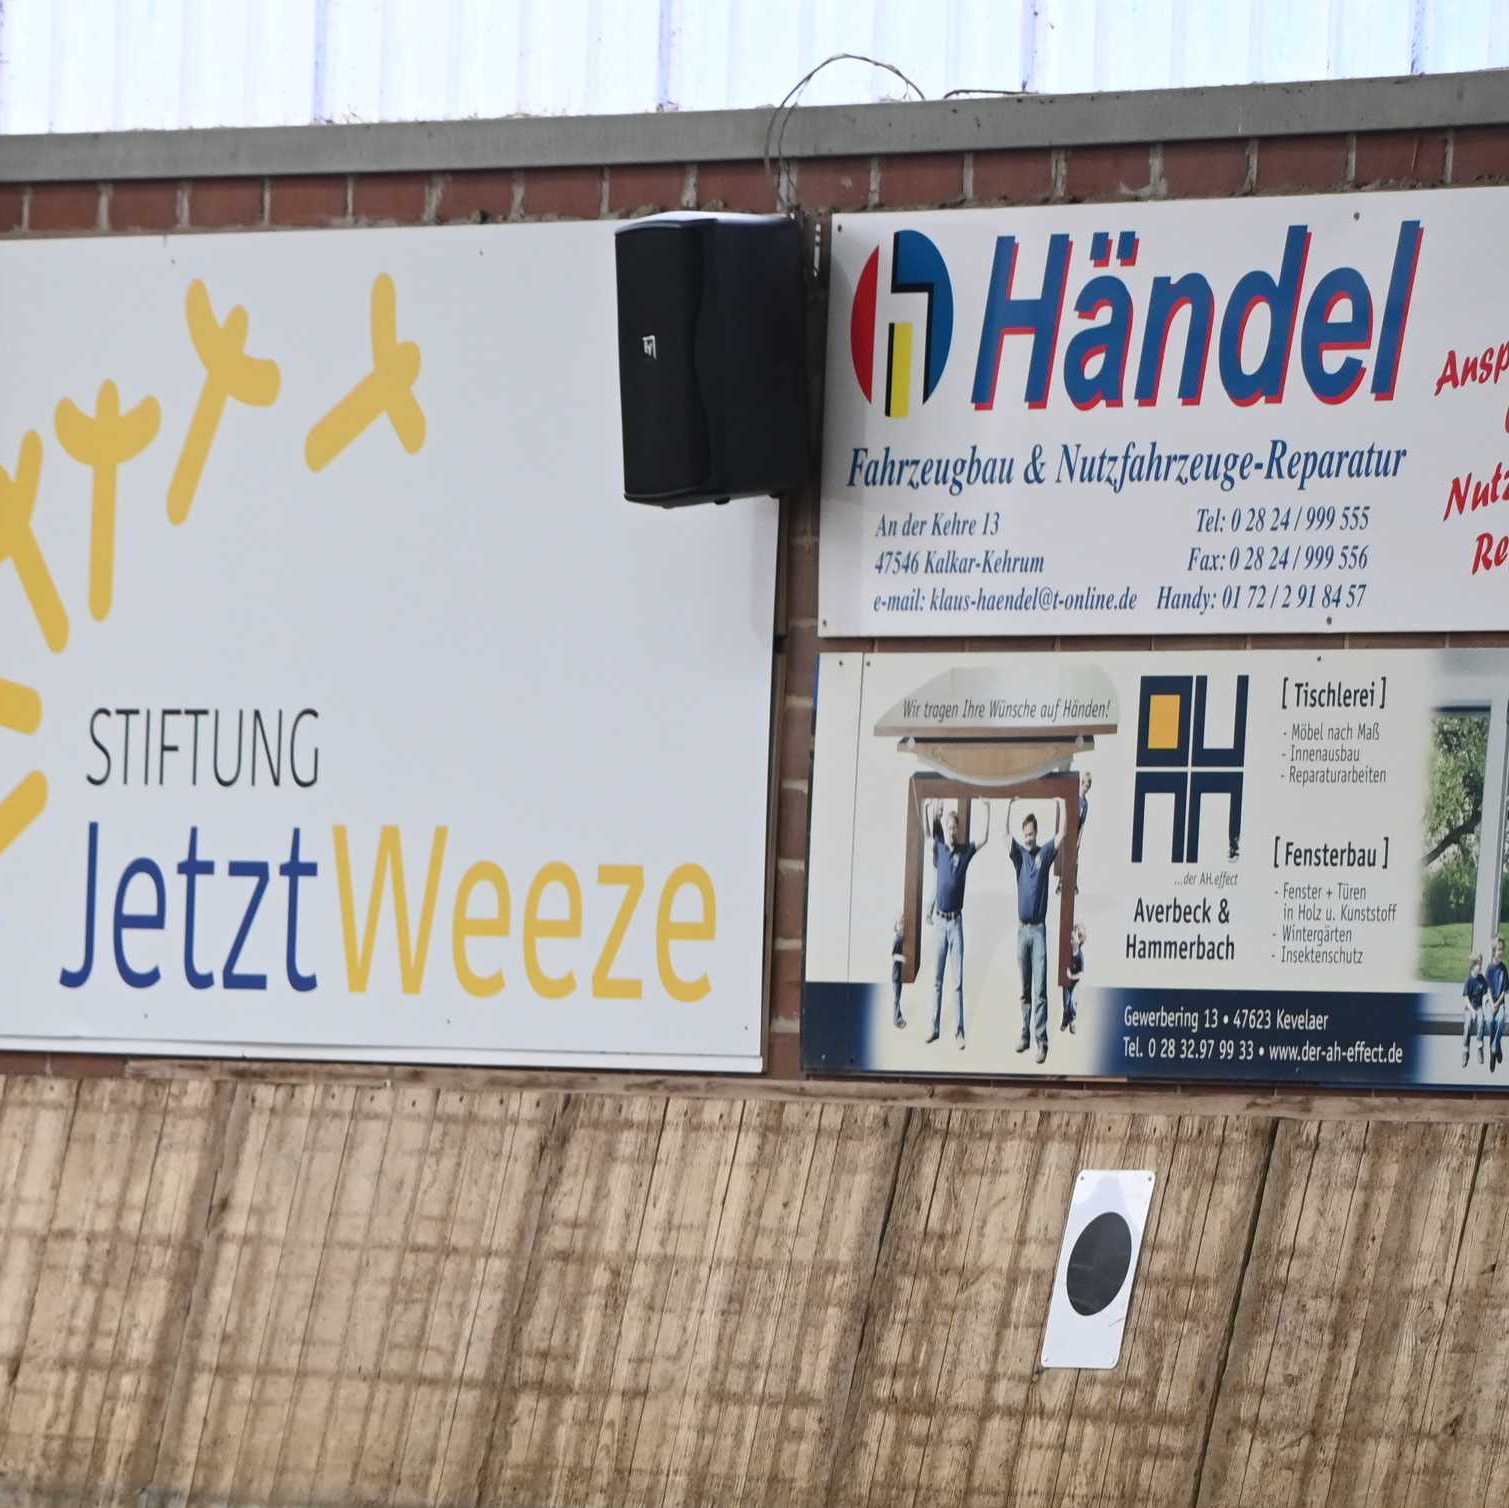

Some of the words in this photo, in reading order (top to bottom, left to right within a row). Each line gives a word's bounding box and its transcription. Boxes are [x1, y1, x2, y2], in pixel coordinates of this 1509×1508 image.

[971, 220, 1424, 411] Händel
[846, 445, 1014, 496] Fahrzeugbau
[1023, 443, 1046, 484] &
[1055, 439, 1407, 494] Nutzfahrzeuge-Reparatur
[875, 513, 897, 537] An
[902, 512, 927, 537] der
[931, 512, 977, 536] Kehre
[981, 511, 1001, 535] 13
[1196, 508, 1225, 532] Tel:
[1230, 507, 1241, 532] 0
[1245, 507, 1266, 532] 28
[1270, 507, 1290, 531] 24
[1293, 506, 1303, 532] /
[1306, 506, 1335, 531] 999
[1339, 505, 1370, 530] 555
[875, 550, 920, 574] 47546
[924, 549, 1045, 574] Kalkar-Kehrum
[1187, 546, 1225, 571] Fax:
[1229, 546, 1240, 571] 0
[1244, 546, 1264, 570] 28
[1268, 546, 1289, 570] 24
[1292, 545, 1302, 571] /
[1304, 545, 1334, 570] 999
[1338, 544, 1369, 569] 556
[873, 587, 925, 612] e-mail:
[930, 585, 1138, 611] klaus-haendel@t-online.de
[1156, 585, 1217, 616] Handy:
[1222, 585, 1242, 609] 01
[1247, 585, 1267, 609] 72
[1270, 584, 1279, 609] /
[1281, 585, 1292, 609] 2
[1297, 584, 1317, 608] 91
[1321, 584, 1342, 608] 84
[1346, 584, 1367, 608] 57
[1294, 681, 1375, 708] Tischlerei
[902, 699, 919, 718] Wir
[924, 699, 959, 722] tragen
[962, 698, 985, 718] Ihre
[989, 698, 1037, 719] Wünsche
[1040, 698, 1061, 722] auf
[1063, 698, 1111, 719] Händen!
[1291, 722, 1324, 741] Möbel
[1327, 722, 1353, 741] nach
[1357, 722, 1380, 741] Maß
[86, 708, 321, 788] STIFTUNG
[1290, 743, 1361, 762] Innenausbau
[1289, 765, 1386, 788] Reparaturarbeiten
[1285, 841, 1376, 867] Fensterbau
[1200, 871, 1238, 889] AH.effect
[1283, 881, 1322, 900] Fenster
[1337, 882, 1366, 900] Türen
[1134, 896, 1212, 924] Averbeck
[1218, 897, 1230, 924] &
[1283, 902, 1294, 921] in
[1298, 902, 1322, 921] Holz
[1326, 909, 1335, 921] u.
[1341, 904, 1397, 922] Kunststoff
[1126, 934, 1235, 960] Hammerbach
[1282, 924, 1352, 947] Wintergärten
[1281, 945, 1364, 964] Insektenschutz
[1123, 1006, 1199, 1033] Gewerbering
[1204, 1008, 1218, 1028] 13
[1232, 1009, 1272, 1030] 47623
[1276, 1008, 1329, 1031] Kevelaer
[1123, 1036, 1144, 1058] Tel.
[1148, 1038, 1156, 1058] 0
[1160, 1039, 1176, 1059] 28
[1179, 1039, 1215, 1059] 32.97
[1219, 1040, 1234, 1060] 99
[1239, 1040, 1254, 1060] 33
[1269, 1040, 1403, 1063] www.der-ah-effect.de
